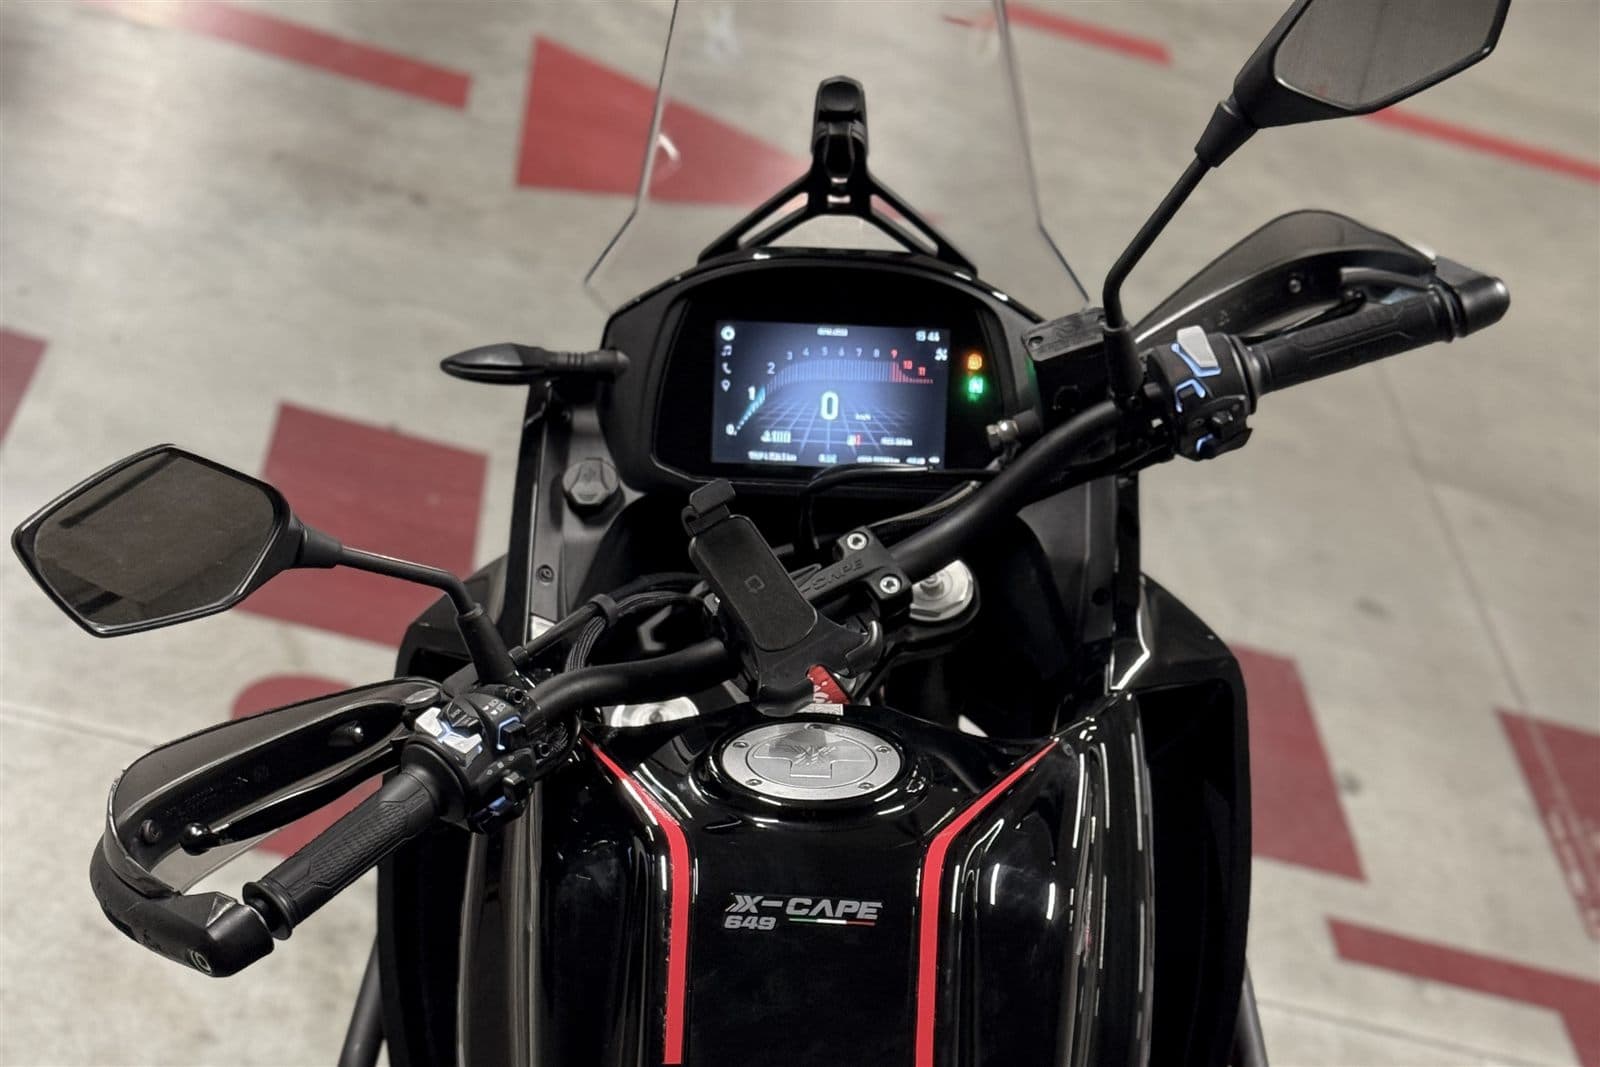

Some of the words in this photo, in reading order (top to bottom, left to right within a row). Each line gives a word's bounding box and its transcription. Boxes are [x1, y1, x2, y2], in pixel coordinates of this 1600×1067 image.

[767, 362, 776, 375] 2
[786, 351, 793, 361] 3
[802, 347, 810, 357] 4
[838, 347, 845, 357] 6
[856, 348, 863, 358] 7
[873, 348, 880, 358] 8
[891, 349, 898, 359] 9
[903, 360, 913, 370] 10
[918, 367, 926, 377] 11
[820, 390, 839, 421] 0
[726, 894, 883, 920] X-CAPE
[724, 915, 777, 931] 649
